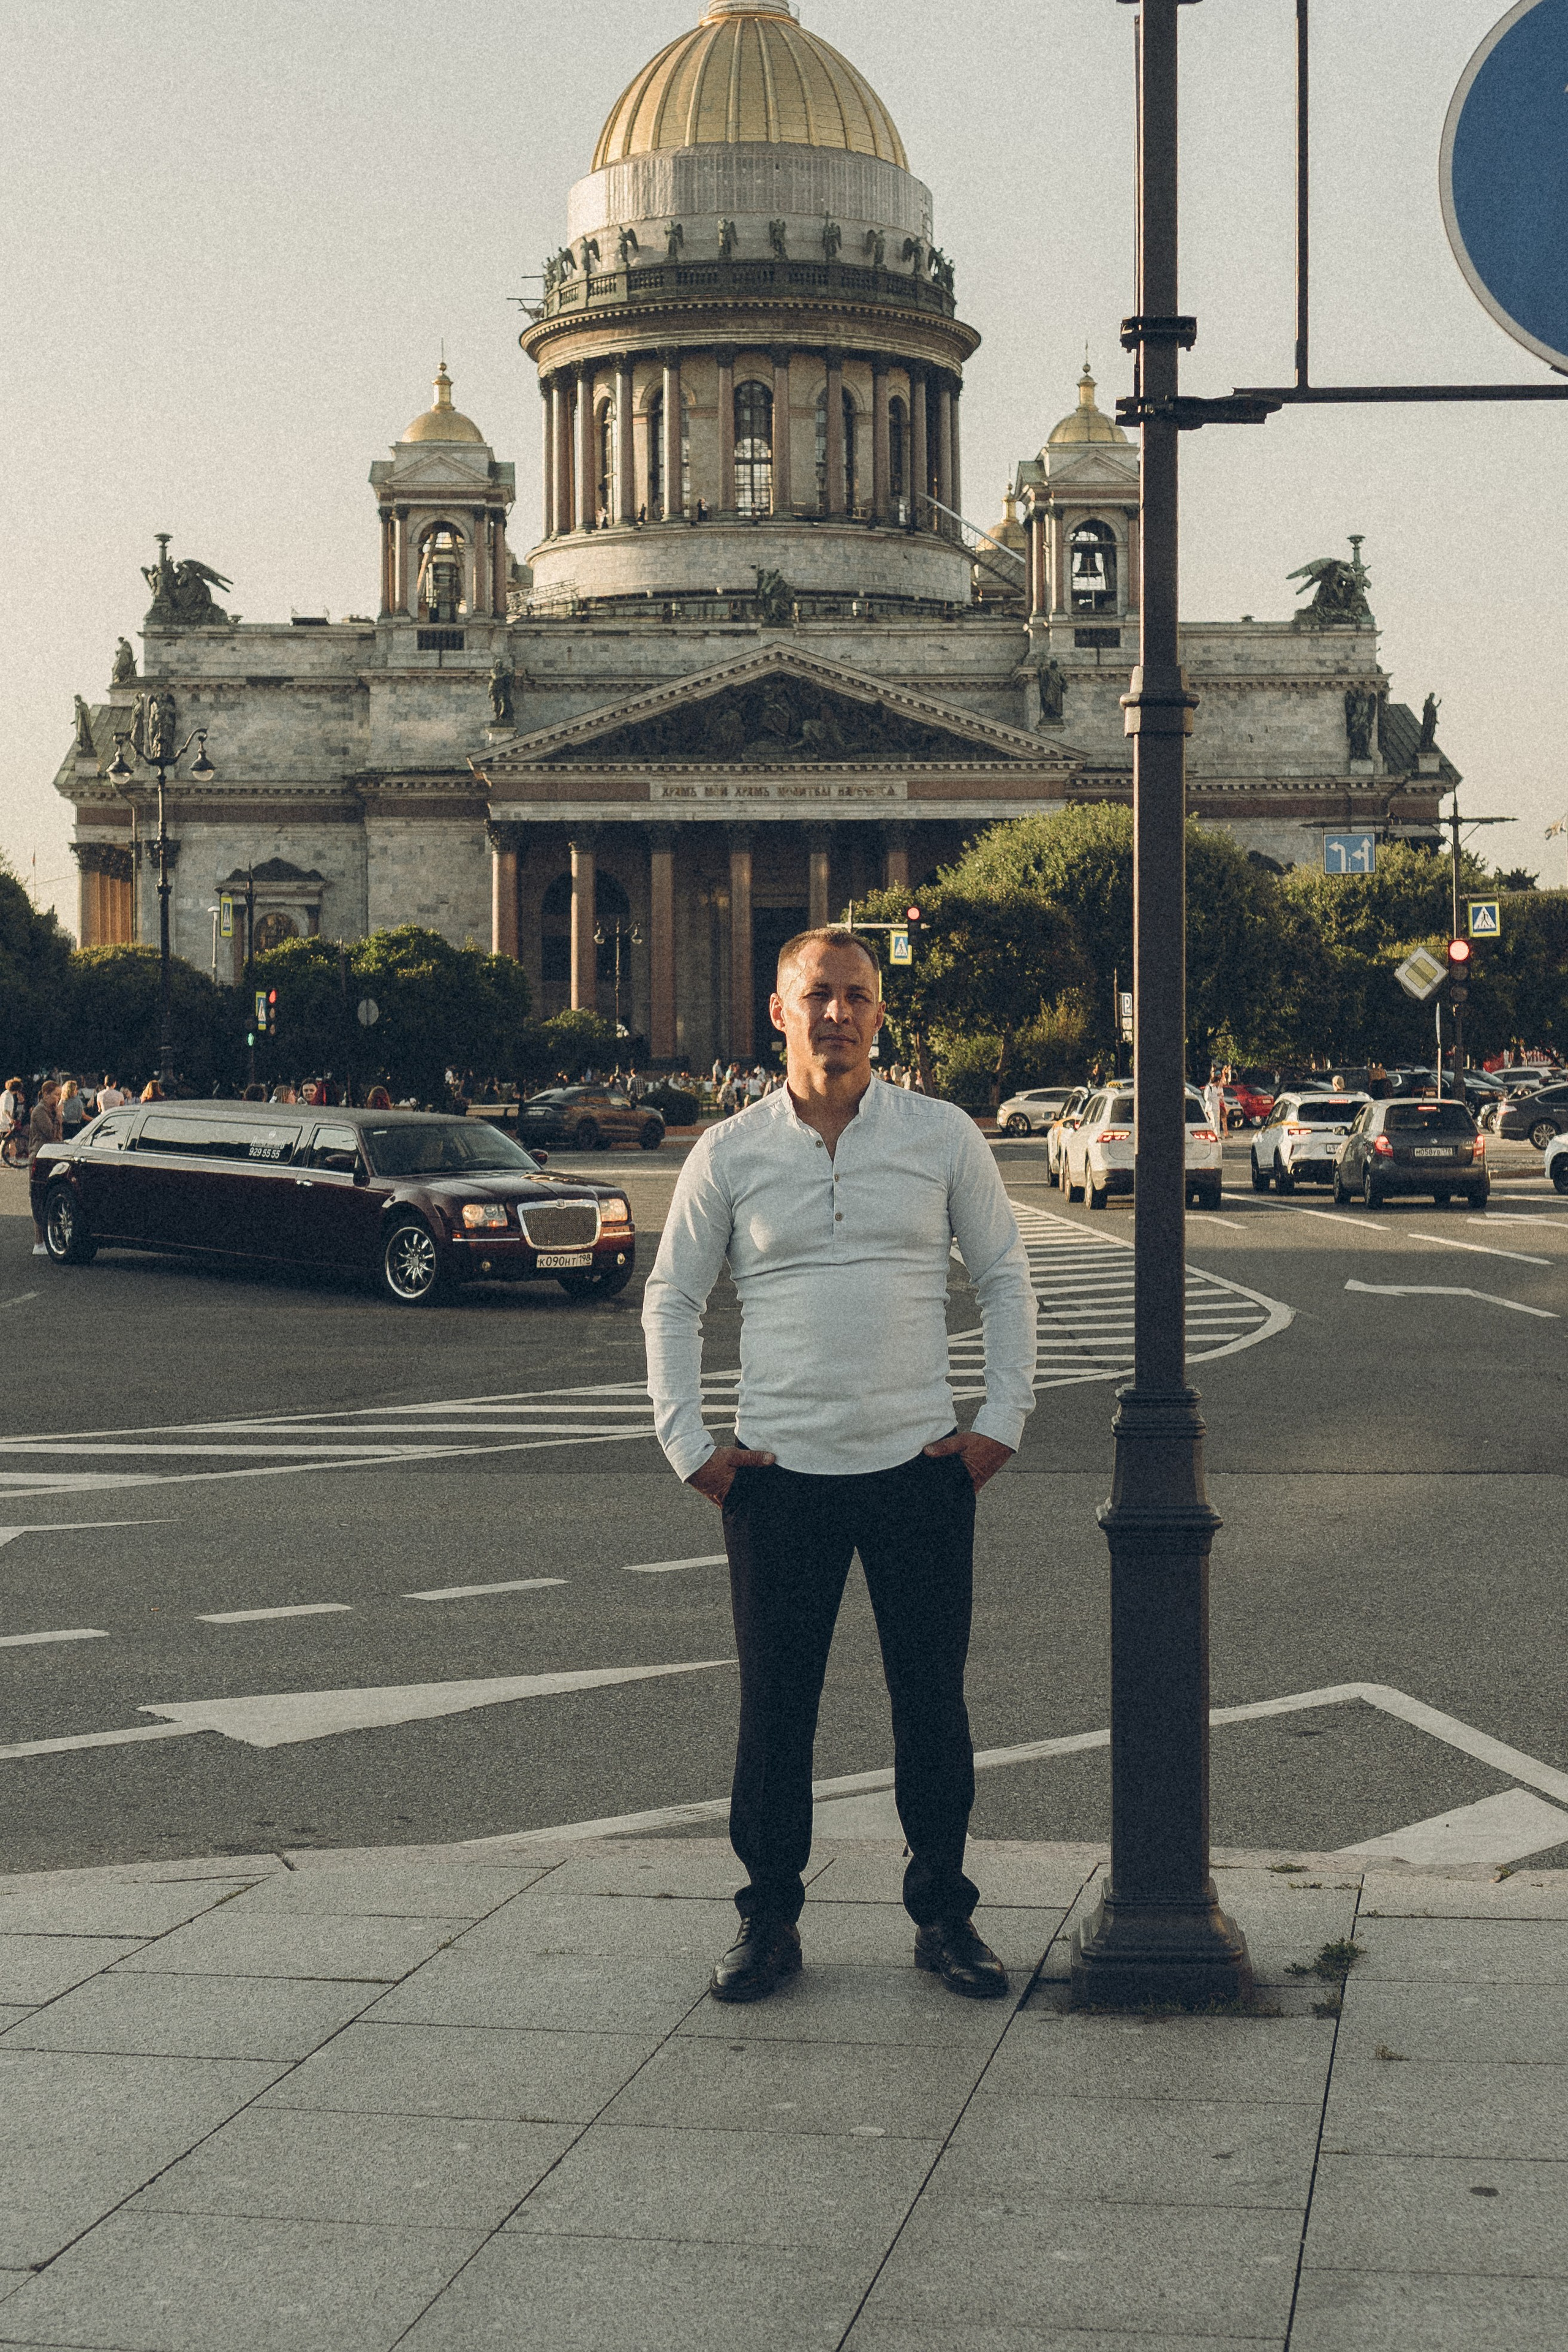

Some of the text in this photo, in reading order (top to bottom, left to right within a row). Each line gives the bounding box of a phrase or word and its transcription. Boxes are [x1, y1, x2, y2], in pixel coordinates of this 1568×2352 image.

[662, 786, 697, 796] ХРАМЪ
[735, 786, 770, 796] ХРАМЪ
[249, 1147, 281, 1159] 929 55 55
[579, 1254, 591, 1262] 198
